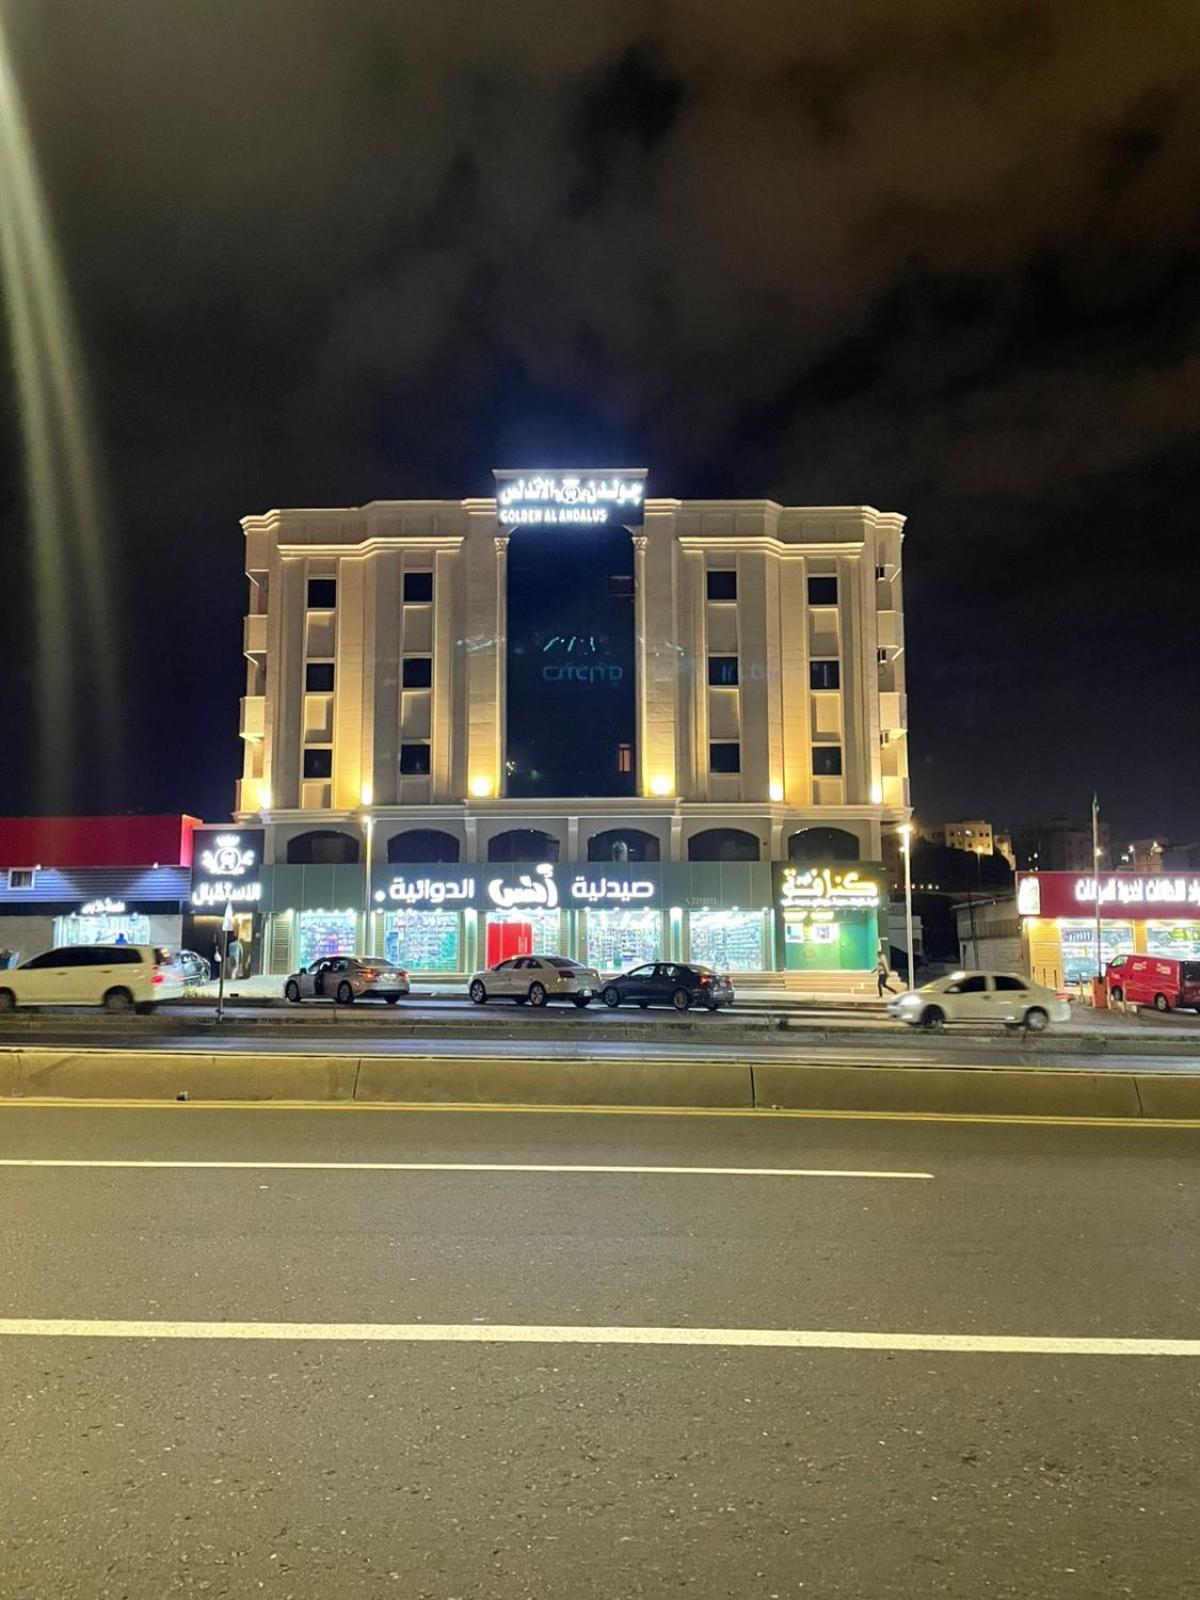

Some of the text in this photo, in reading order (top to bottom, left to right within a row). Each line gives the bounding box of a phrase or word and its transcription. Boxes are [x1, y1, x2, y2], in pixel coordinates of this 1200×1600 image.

[501, 508, 608, 523] GOLDEN AL ANDALUS
[390, 877, 475, 904] الدوائية
[571, 875, 654, 902] صيدلية
[782, 868, 878, 898] كنافة
